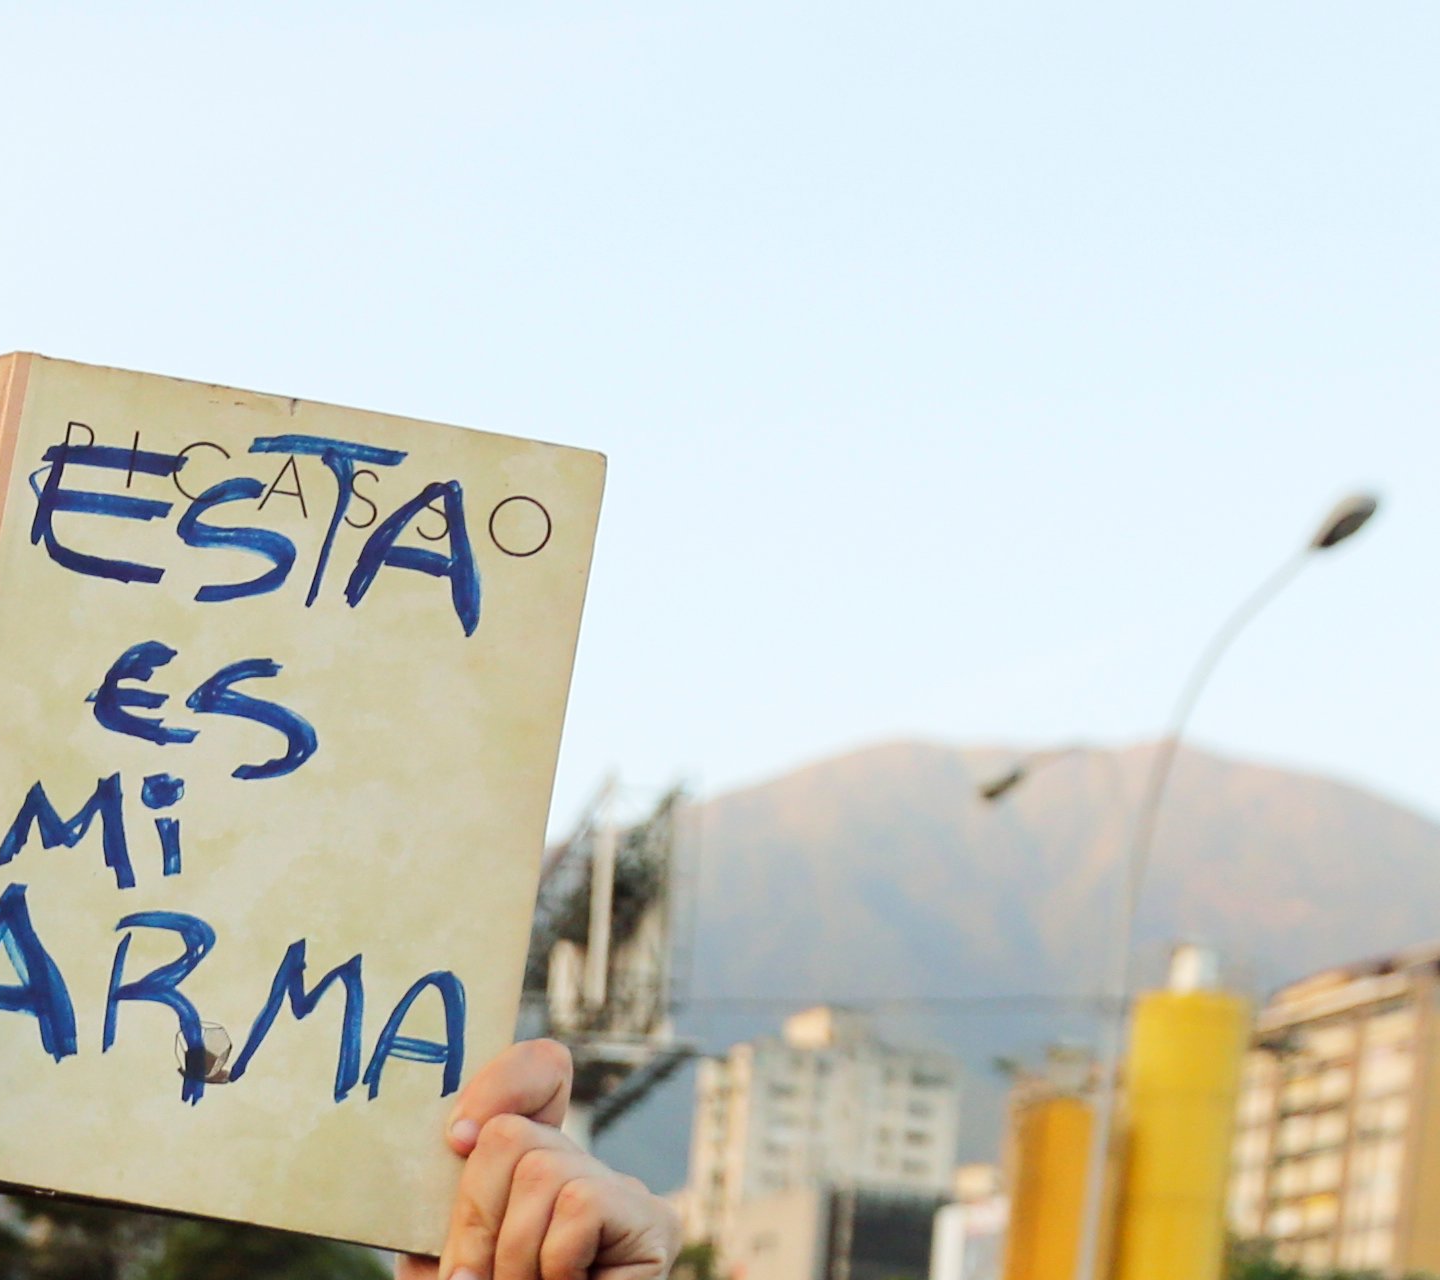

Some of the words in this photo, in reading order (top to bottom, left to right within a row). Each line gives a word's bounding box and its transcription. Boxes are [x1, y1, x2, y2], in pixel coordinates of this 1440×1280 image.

[29, 434, 481, 637] ESTA
[62, 421, 553, 557] PICASSO
[85, 640, 317, 780] ES
